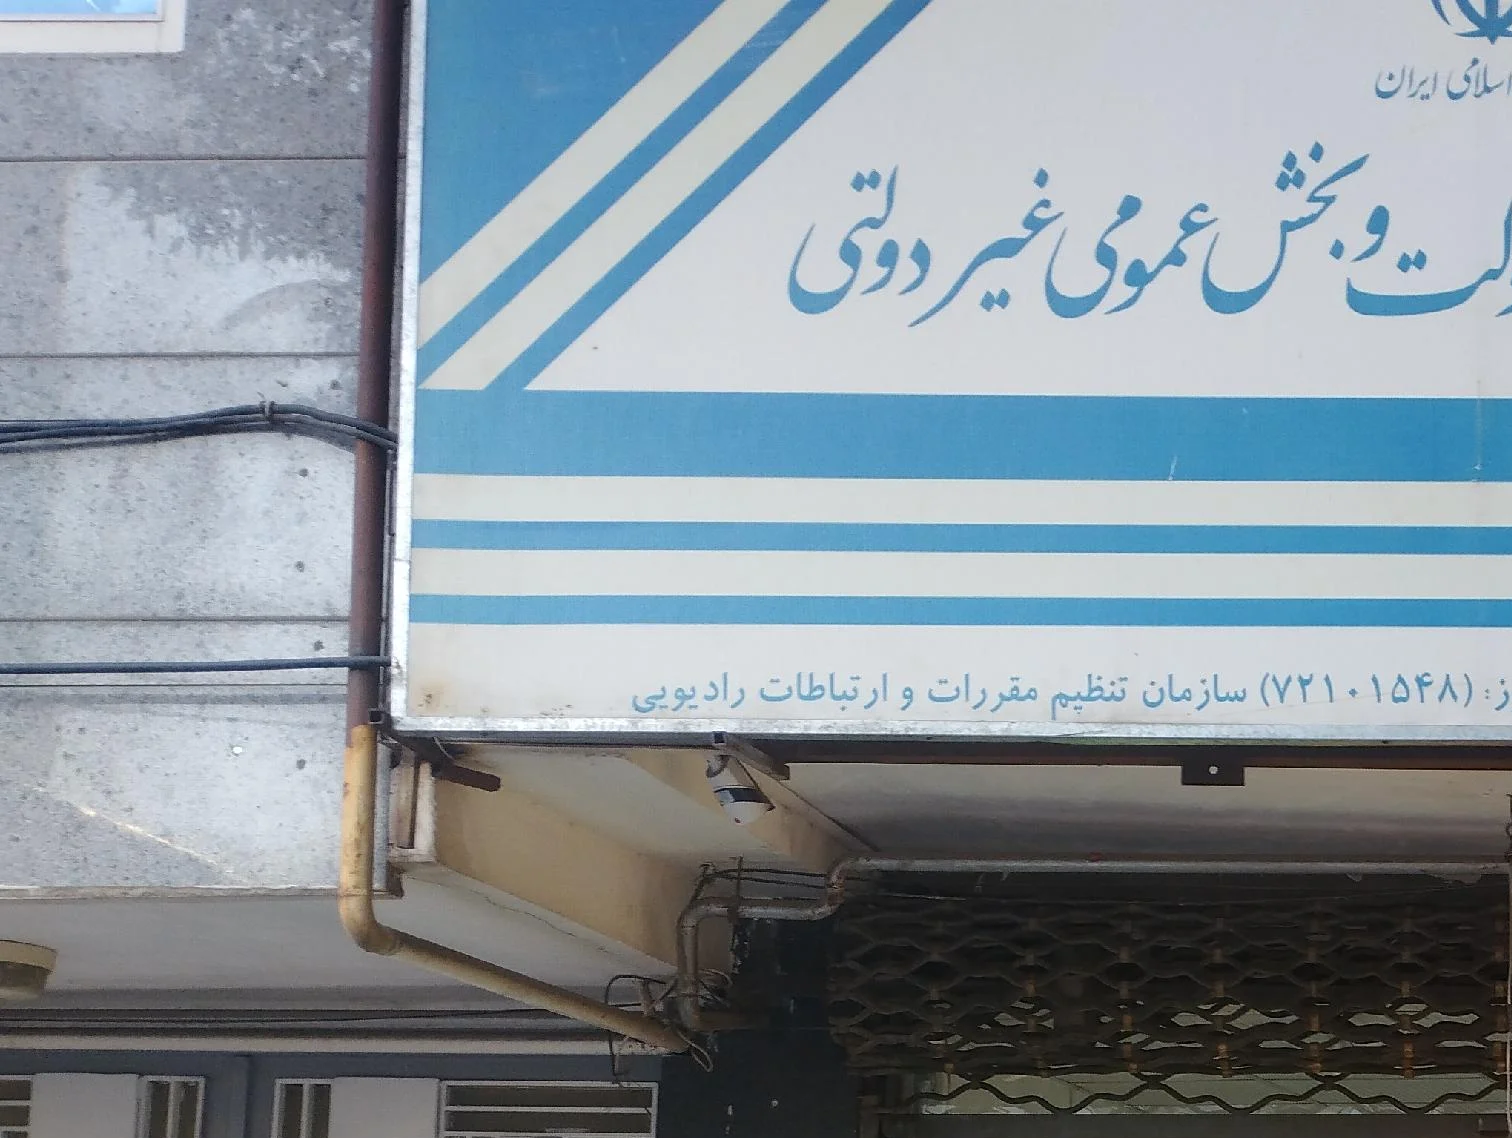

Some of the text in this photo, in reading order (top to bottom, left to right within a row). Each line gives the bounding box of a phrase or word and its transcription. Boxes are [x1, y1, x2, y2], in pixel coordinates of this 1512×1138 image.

[1374, 63, 1439, 101] ایران
[787, 164, 931, 316] دولتی
[907, 167, 1066, 328] غیر
[1201, 140, 1371, 315] بخش
[1350, 204, 1391, 263] و
[1044, 193, 1219, 319] عمومی
[630, 672, 746, 714] رادیویی
[758, 671, 890, 712] ارتباطات
[900, 688, 914, 712] و
[927, 673, 1039, 715] مقررات
[1050, 673, 1129, 721] تنظیم
[1142, 674, 1248, 713] سازمان
[1260, 671, 1474, 710] (۷۲۱۰۱۵۴۸)
